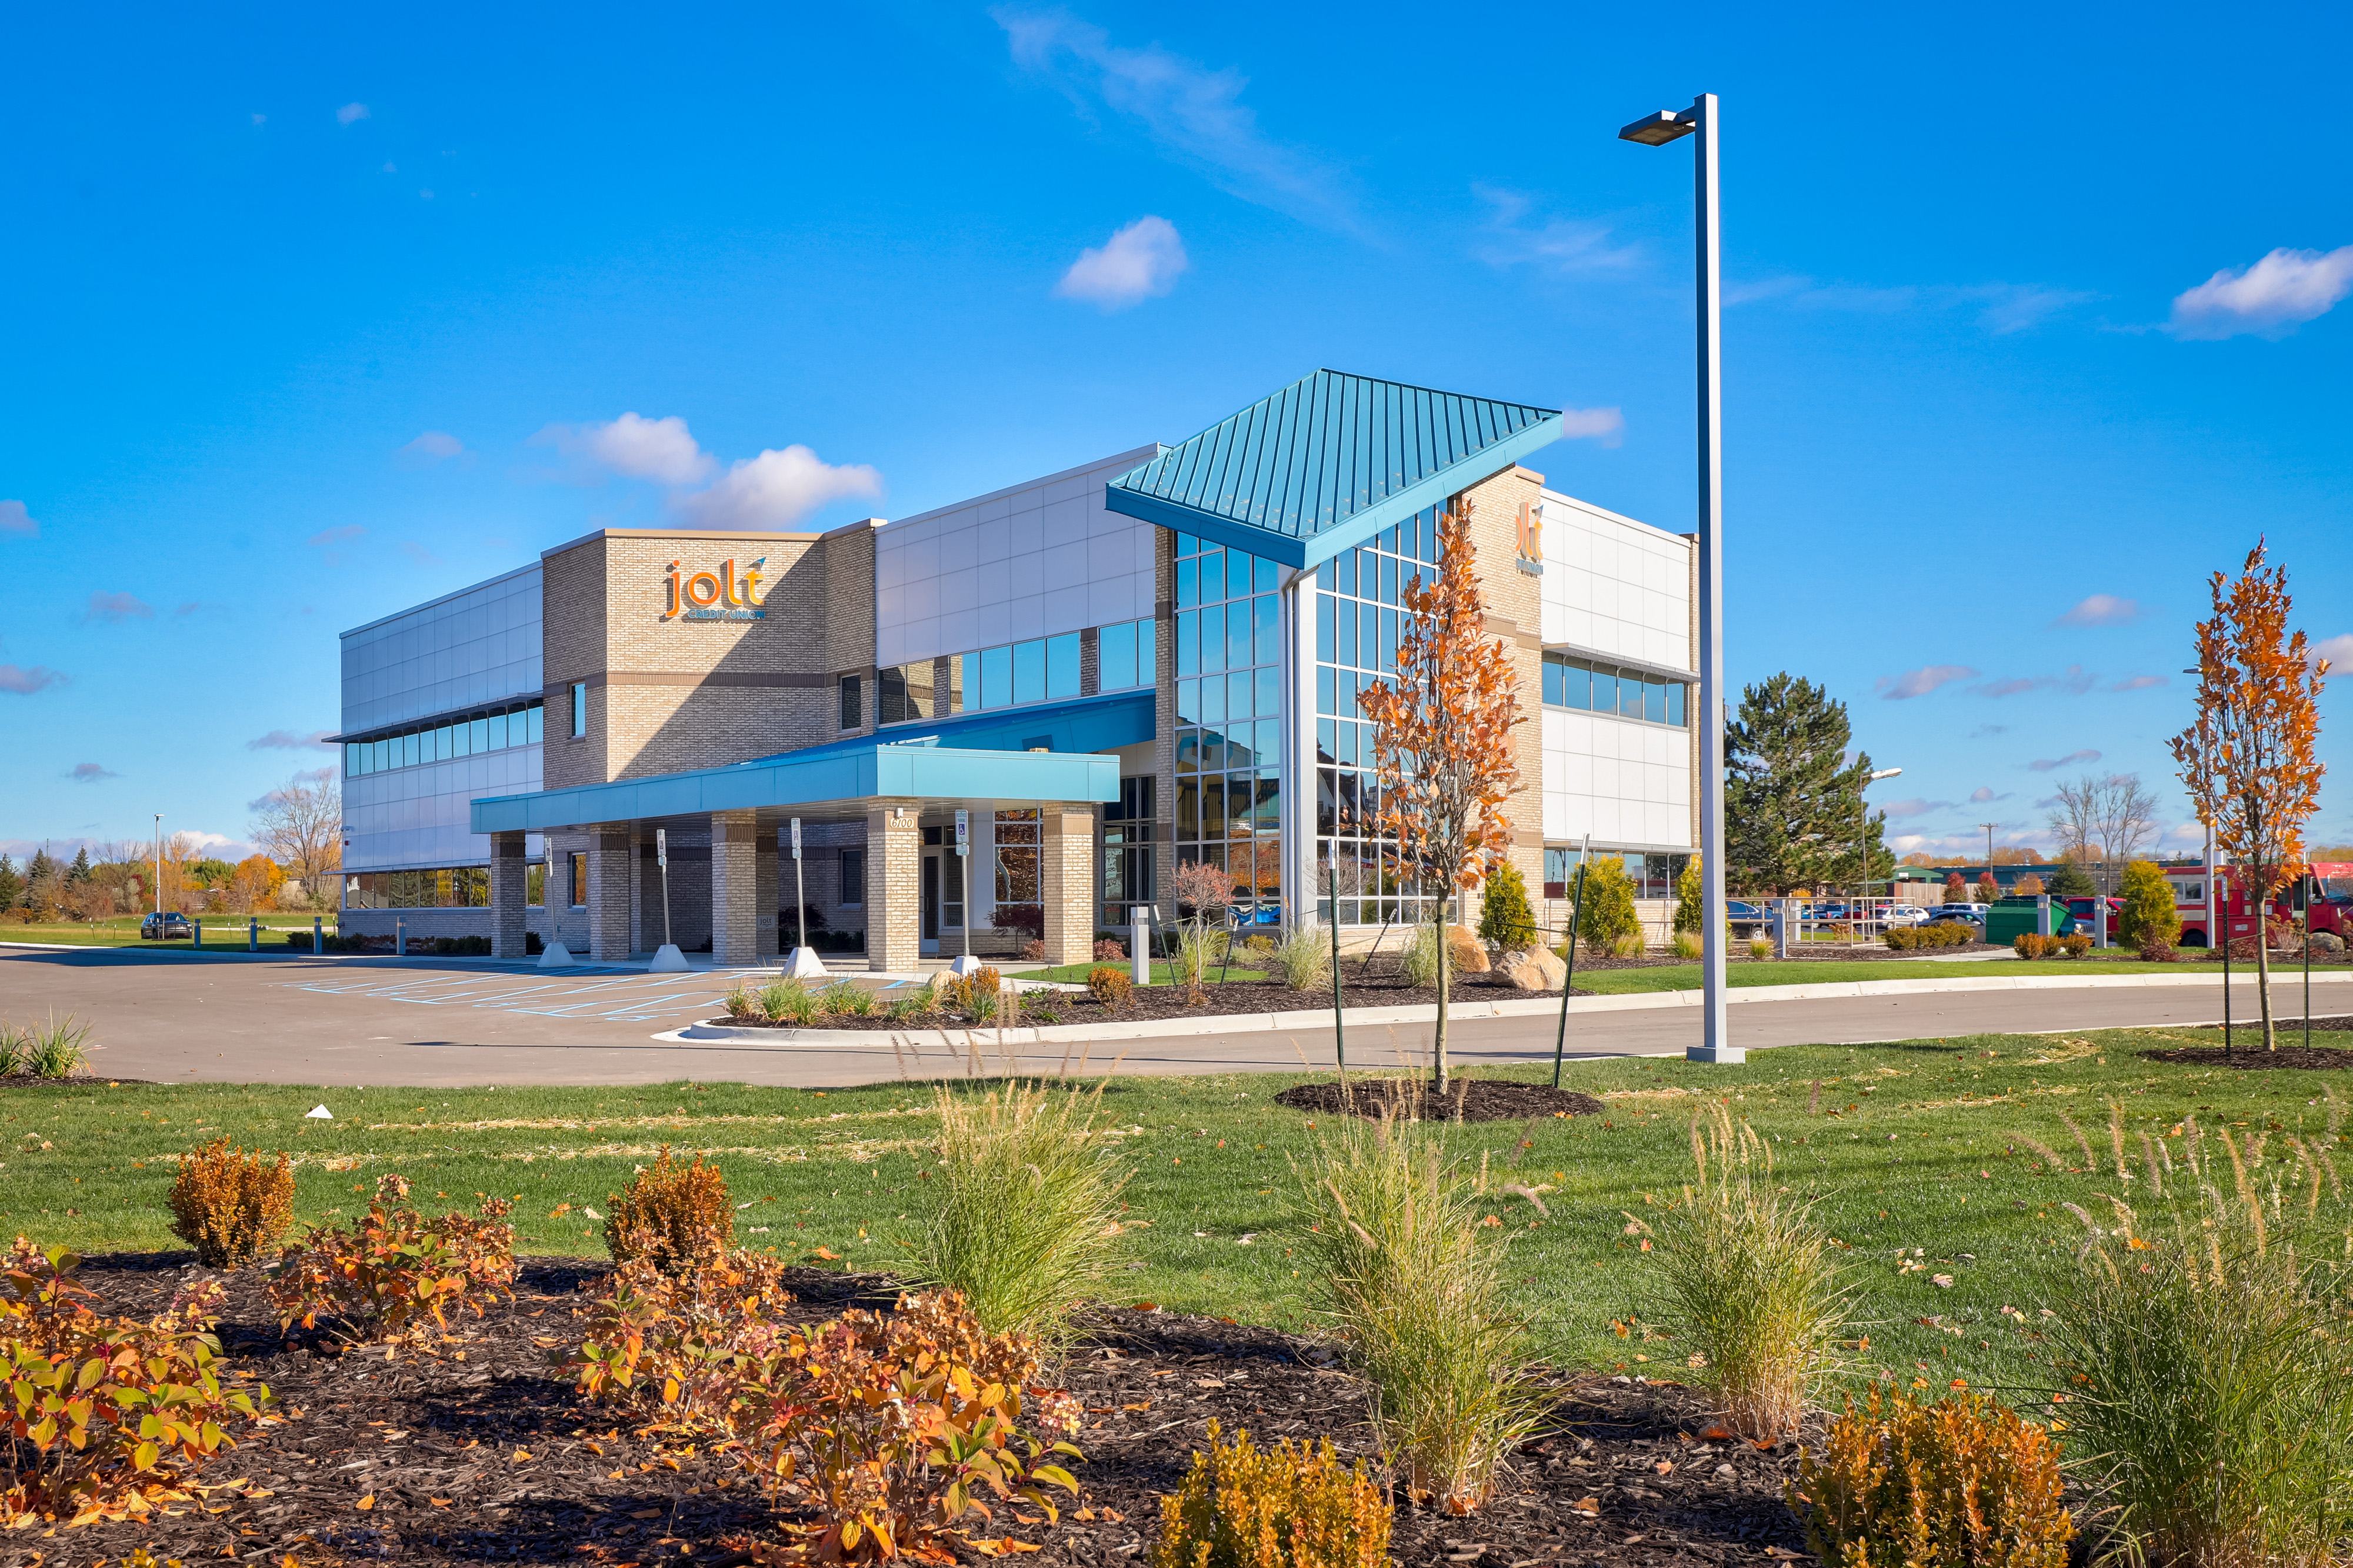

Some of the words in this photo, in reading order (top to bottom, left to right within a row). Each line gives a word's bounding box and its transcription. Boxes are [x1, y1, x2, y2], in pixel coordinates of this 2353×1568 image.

[1527, 561, 1544, 575] UNION
[666, 556, 766, 618] jolt
[688, 609, 727, 619] CREDIT
[729, 609, 766, 619] UNION
[892, 818, 912, 828] 6100
[759, 916, 772, 925] jolt
